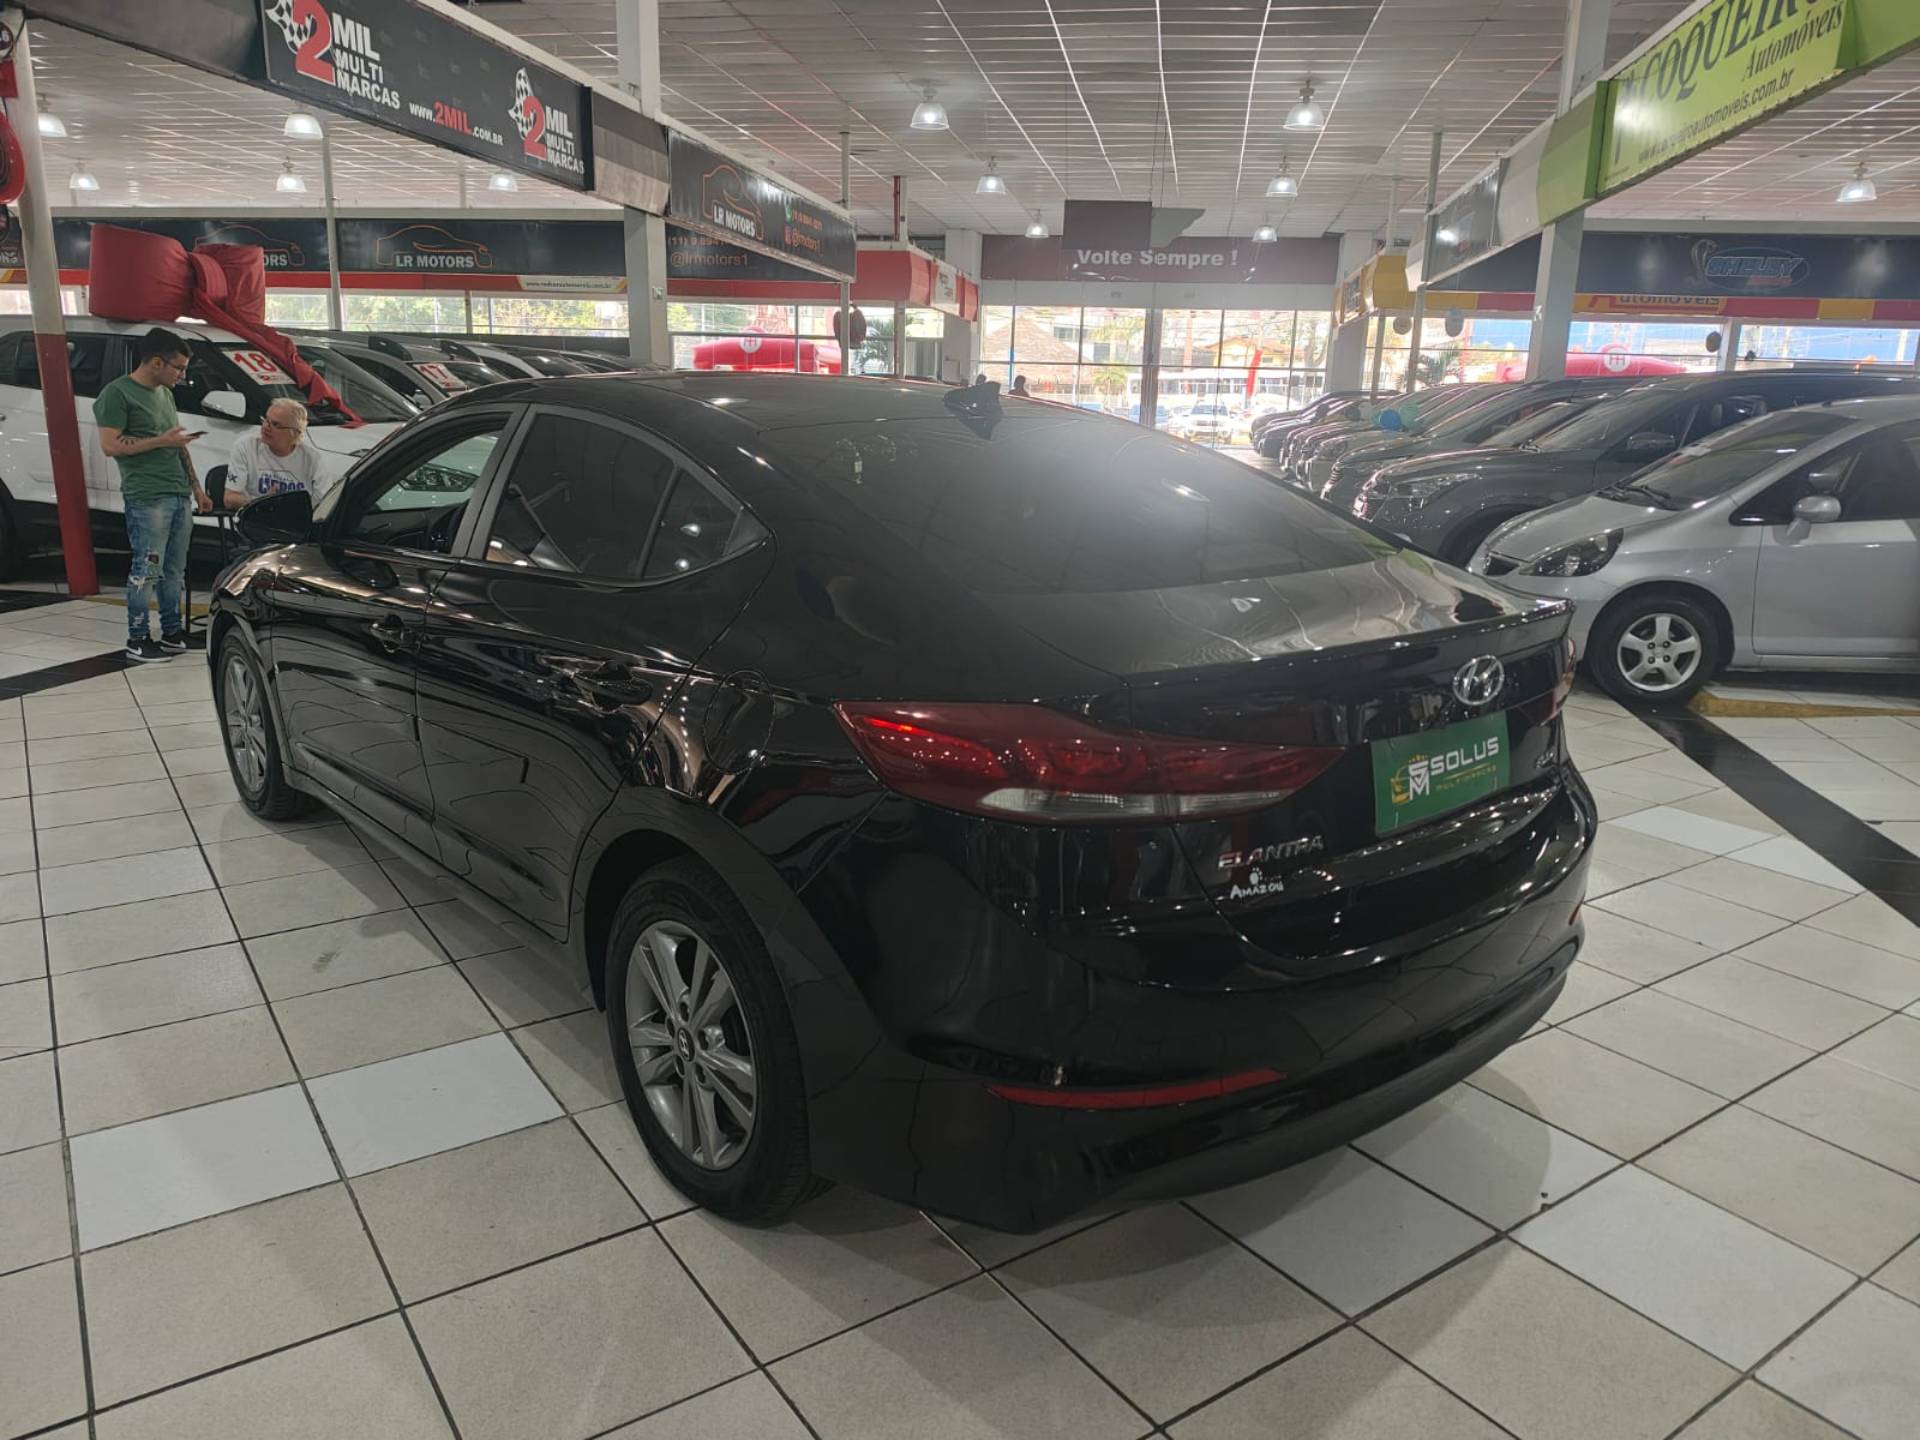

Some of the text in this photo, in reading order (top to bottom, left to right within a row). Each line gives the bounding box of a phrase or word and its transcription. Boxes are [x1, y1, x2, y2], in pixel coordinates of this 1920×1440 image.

[292, 0, 380, 86] 2 MIL
[335, 48, 384, 84] MULTI
[336, 69, 401, 110] MARCAS
[522, 96, 574, 160] 2 MIL
[547, 133, 575, 156] MULTI
[547, 149, 585, 175] MARCAS
[714, 205, 756, 237] LR MOTORS
[395, 255, 475, 268] LR MOTORS
[1077, 249, 1132, 265] Volte
[1140, 249, 1224, 269] Sempre
[234, 351, 278, 374] 18
[421, 362, 448, 380] 17
[1430, 736, 1500, 776] SOLUS
[1218, 835, 1323, 870] ELANTRA
